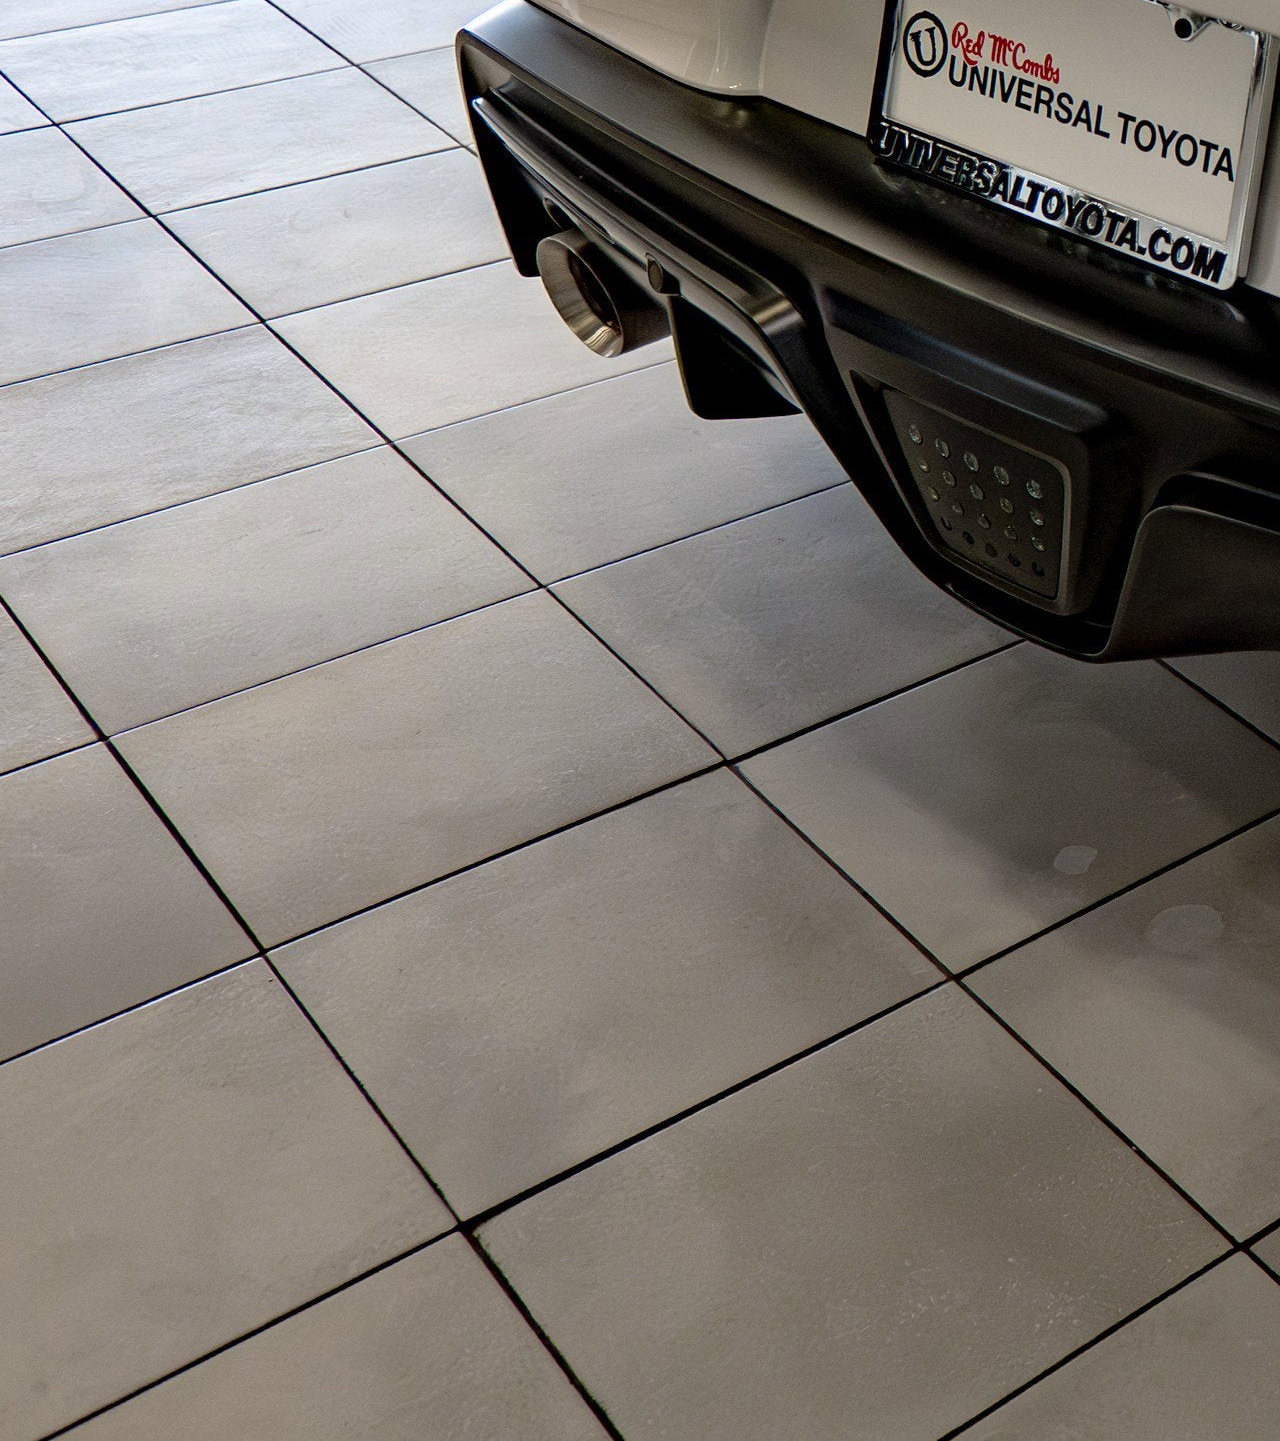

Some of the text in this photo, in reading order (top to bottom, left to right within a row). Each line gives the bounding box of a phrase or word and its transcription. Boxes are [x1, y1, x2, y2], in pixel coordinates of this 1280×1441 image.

[951, 21, 980, 66] Red
[949, 54, 1236, 183] UNIVERSAL TOYOTA
[876, 121, 1229, 285] UNIVERSALTOYOTA.COM
